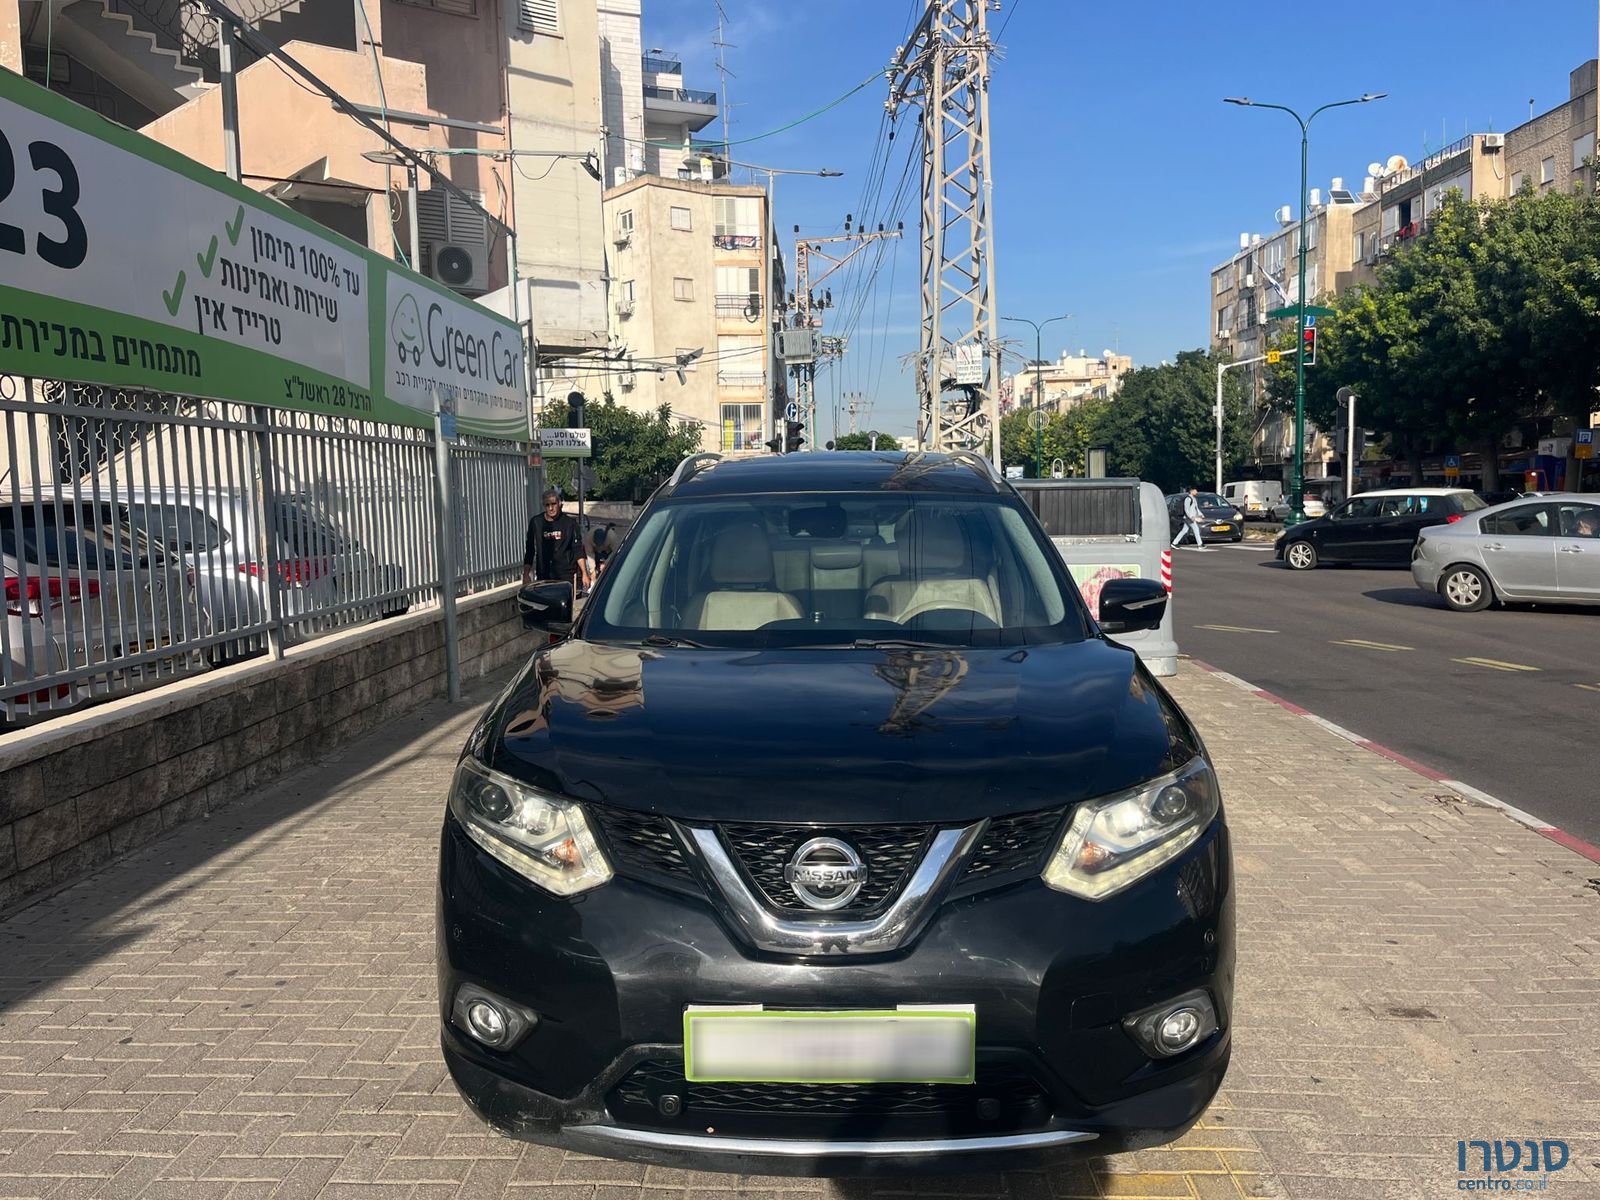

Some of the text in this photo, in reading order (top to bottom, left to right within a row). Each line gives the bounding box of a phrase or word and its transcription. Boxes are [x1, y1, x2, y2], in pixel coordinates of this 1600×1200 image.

[250, 226, 360, 297] עד 100% מימון
[219, 257, 338, 323] שירות ואמינות
[194, 295, 282, 345] טרייד אין
[2, 314, 202, 377] מתמחים במכירת
[428, 302, 518, 389] Green Car
[1270, 353, 1278, 361] 13
[395, 371, 411, 387] רכב
[332, 385, 346, 408] 28
[348, 389, 372, 412] הרצל
[556, 439, 564, 447] זה
[566, 439, 587, 447] אצלנו
[793, 869, 858, 881] NISSAN
